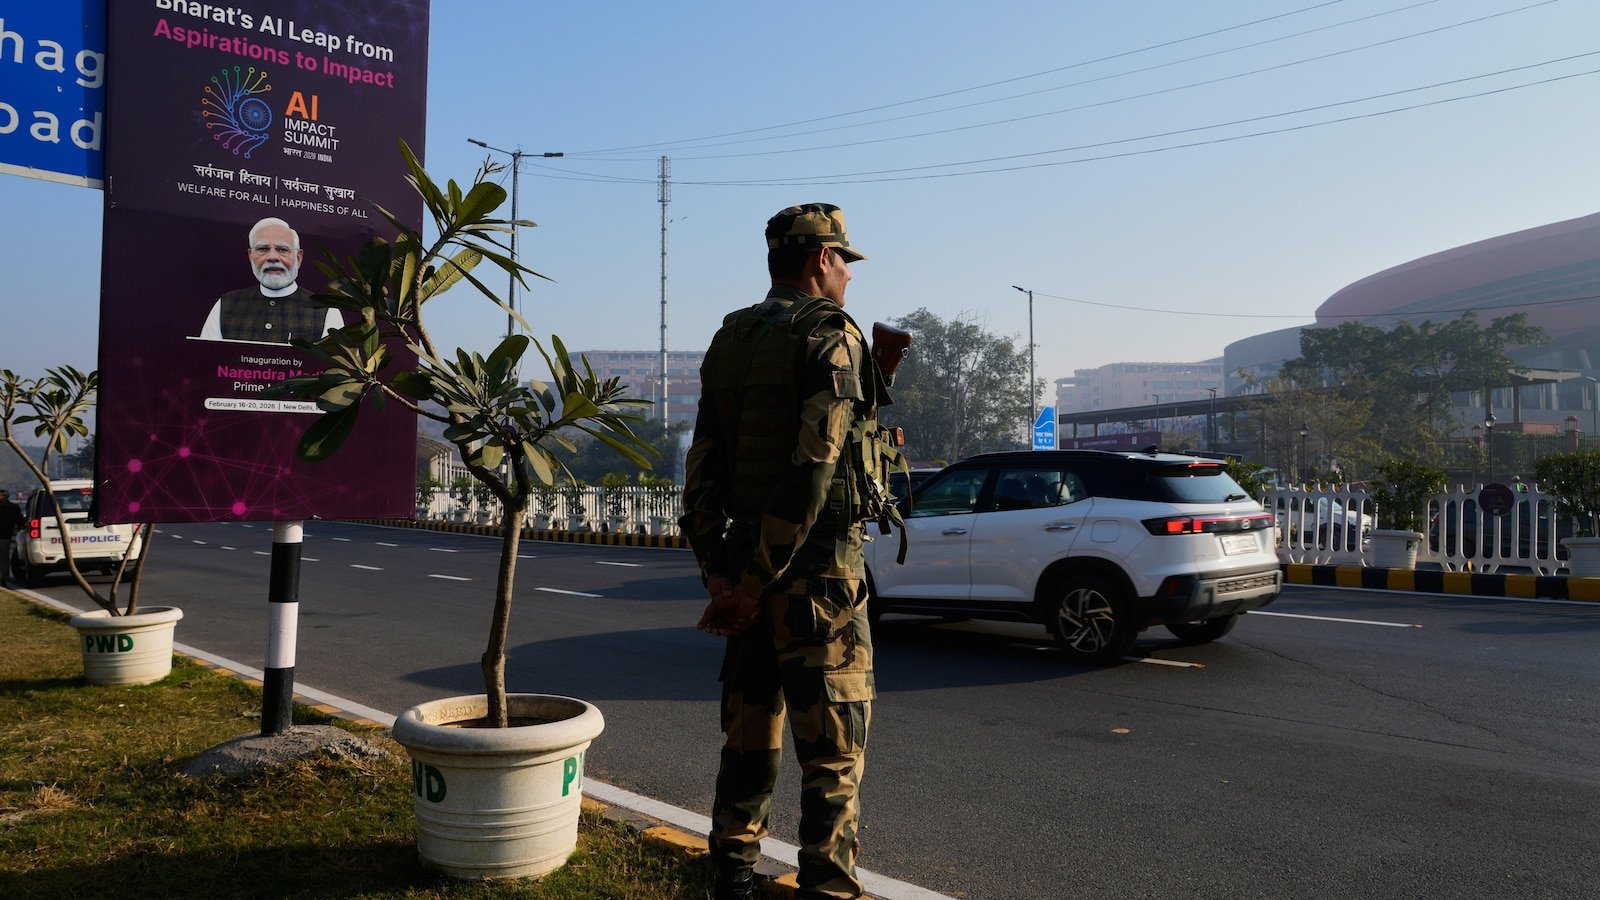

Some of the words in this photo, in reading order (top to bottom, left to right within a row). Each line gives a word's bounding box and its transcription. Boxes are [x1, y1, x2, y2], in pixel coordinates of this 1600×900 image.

[260, 15, 282, 37] AI
[288, 21, 341, 53] Leap
[346, 35, 394, 63] from
[153, 18, 290, 66] Aspirations
[296, 51, 318, 72] to
[323, 56, 394, 88] Impact
[285, 91, 318, 121] AI
[284, 117, 336, 137] IMPACT
[284, 130, 340, 151] SUMMIT
[283, 147, 302, 158] भारत
[303, 151, 316, 160] 2026
[317, 153, 332, 163] INDIA
[193, 163, 234, 181] सर्वजन
[238, 168, 271, 187] हिताय
[281, 177, 319, 195] सर्वजन
[323, 185, 355, 201] सुखाय
[177, 182, 226, 198] WELFARE
[228, 190, 250, 202] FOR
[252, 194, 270, 205] ALL
[281, 198, 335, 214] HAPPINESS
[337, 206, 350, 216] OF
[351, 209, 368, 219] ALL
[241, 355, 291, 366] Inauguration
[293, 357, 303, 367] by
[217, 365, 285, 381] Narendra
[234, 382, 265, 392] Prime
[208, 400, 237, 409] February
[51, 536, 81, 545] DEHI
[83, 534, 121, 543] POLICE
[86, 633, 134, 653] PWD
